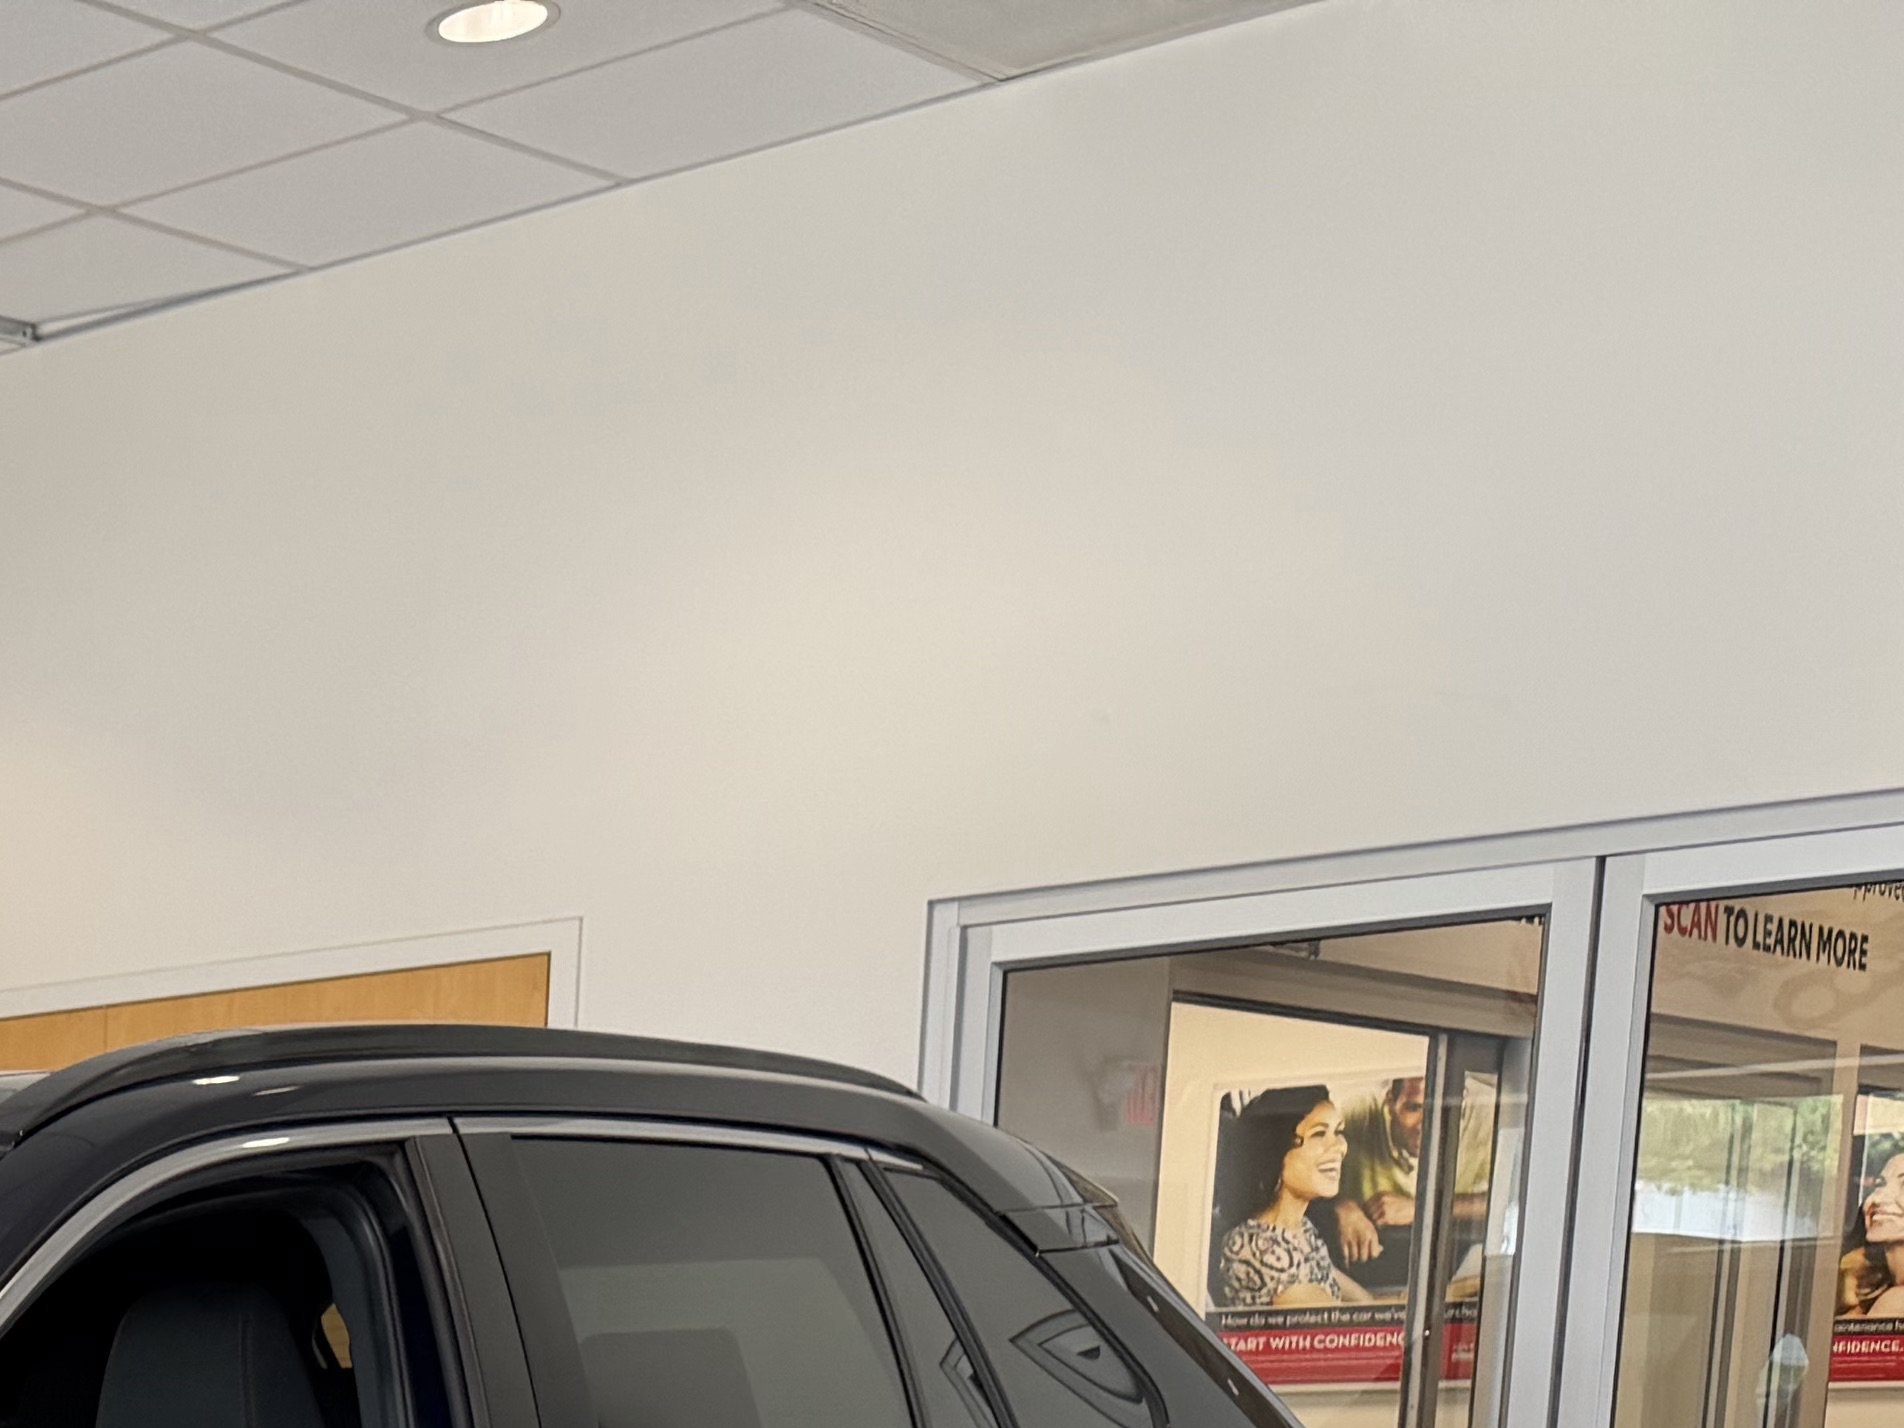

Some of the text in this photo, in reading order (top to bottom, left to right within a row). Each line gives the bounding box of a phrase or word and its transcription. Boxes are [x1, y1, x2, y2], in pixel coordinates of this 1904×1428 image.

[1663, 902, 1870, 973] SCAN TO LEARN MORE
[1330, 1309, 1351, 1323] the
[1351, 1311, 1372, 1321] car
[1269, 1334, 1311, 1351] WITH
